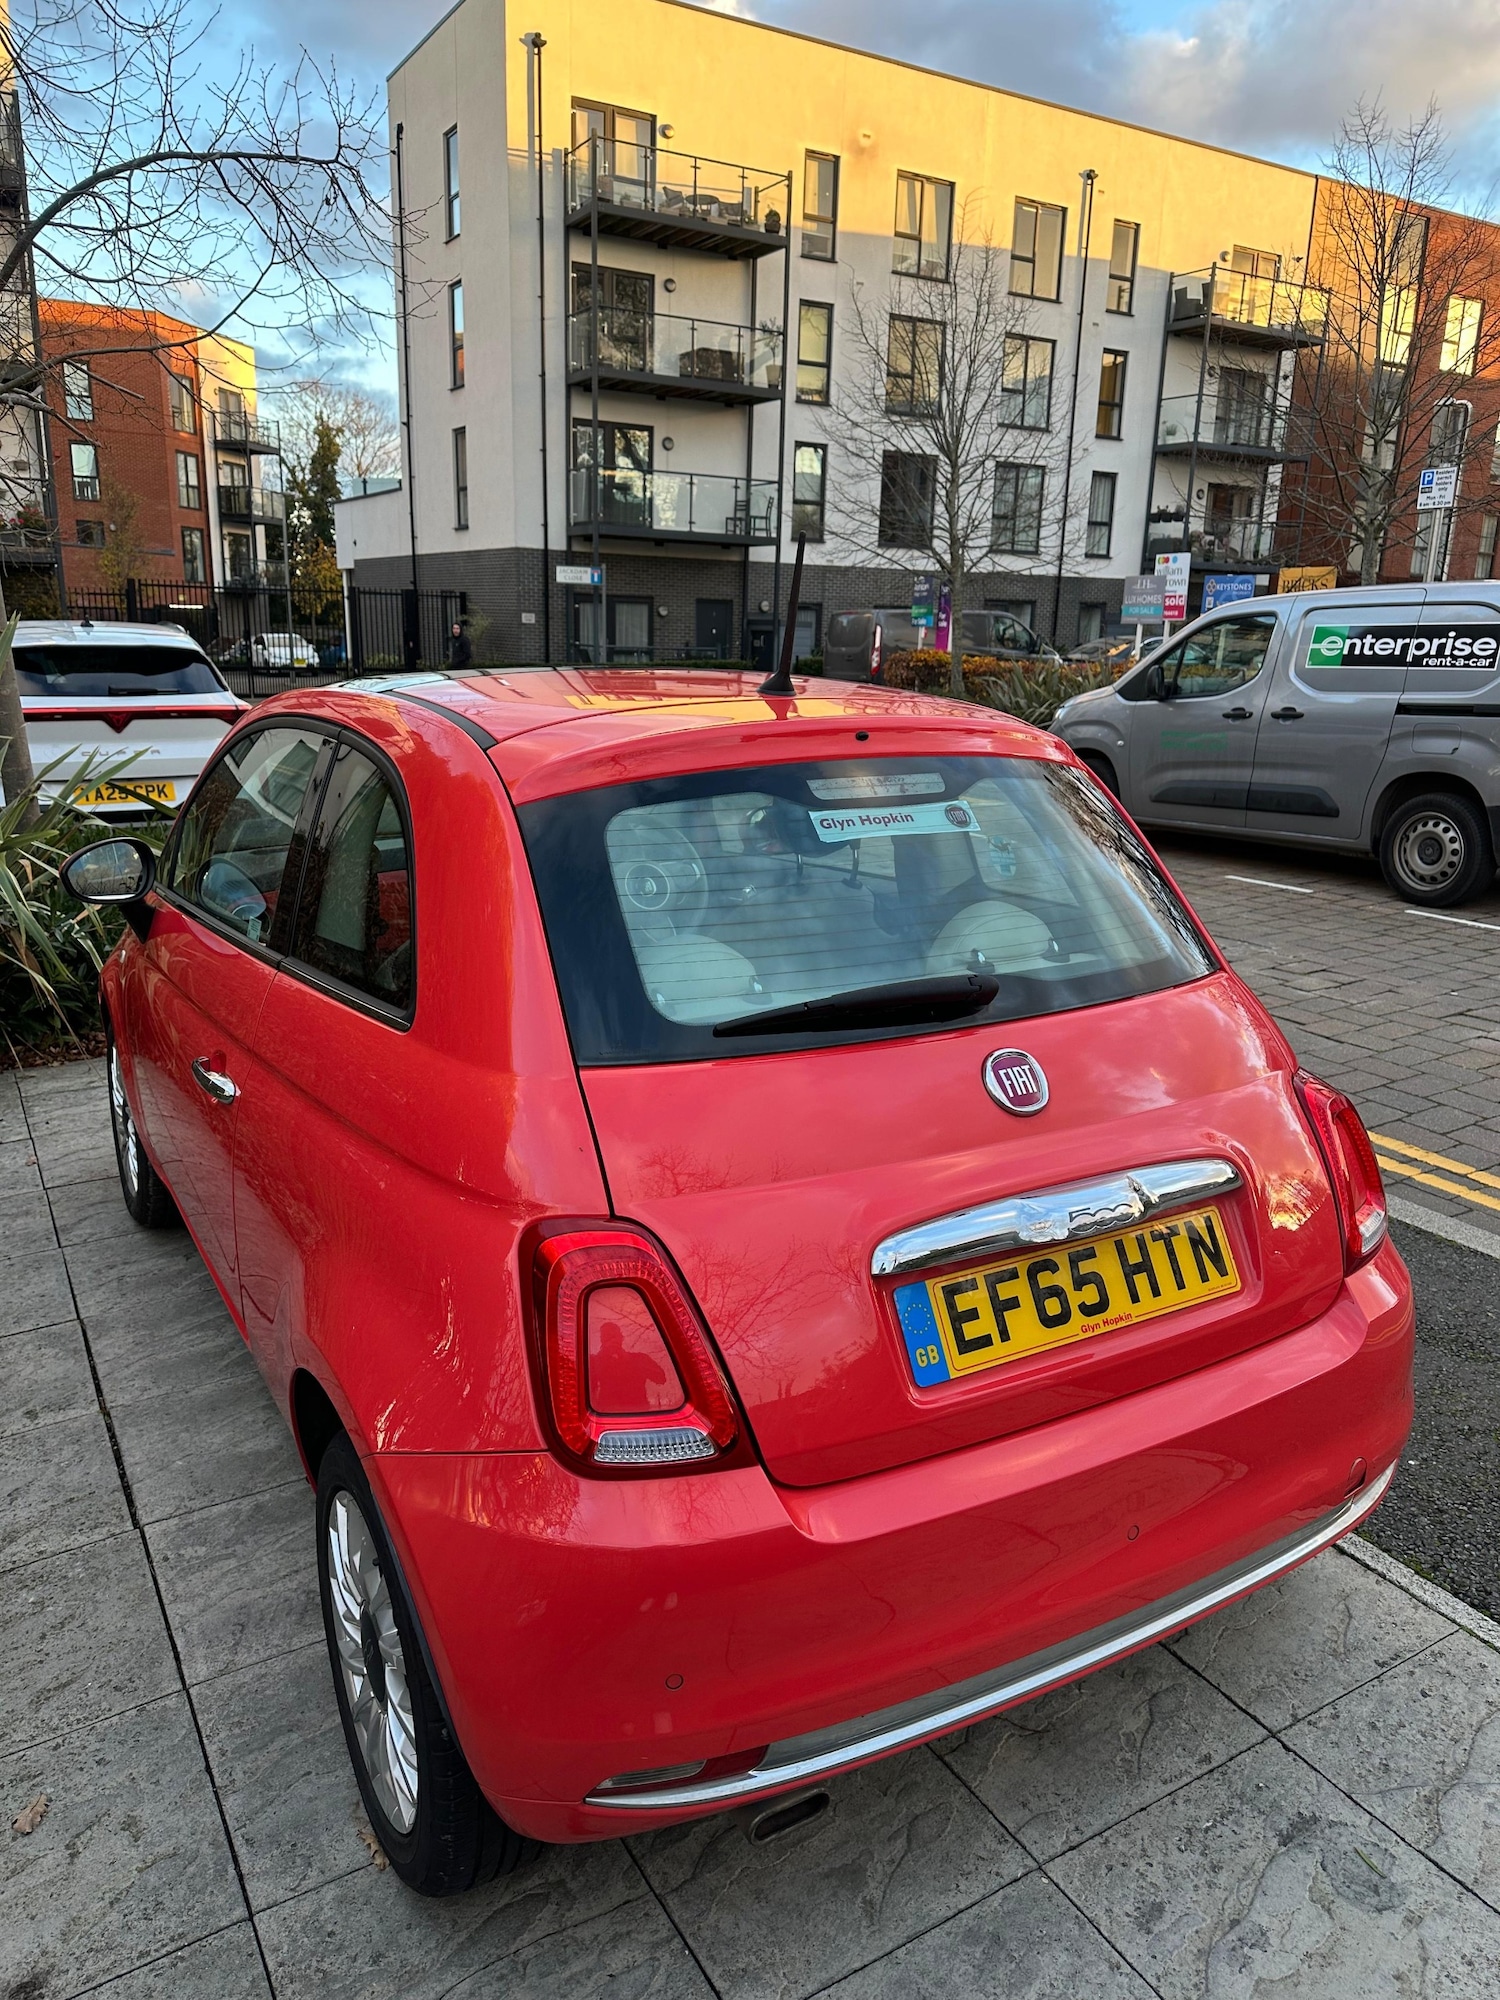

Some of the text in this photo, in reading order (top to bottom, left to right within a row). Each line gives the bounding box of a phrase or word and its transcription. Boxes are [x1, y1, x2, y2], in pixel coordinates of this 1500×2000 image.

[1424, 473, 1433, 485] P
[1165, 578, 1187, 588] rown
[1216, 582, 1252, 591] KEYSTONES
[1165, 594, 1185, 606] sold
[1140, 607, 1154, 615] SALE
[1320, 631, 1497, 662] enterprise
[1422, 657, 1493, 667] rent-a-car
[819, 812, 914, 831] Glyn Hopkin
[998, 1064, 1038, 1098] FIAT
[1067, 1203, 1135, 1234] 500
[940, 1215, 1230, 1357] EF65 HTN
[1080, 1311, 1134, 1335] Glyn Hopkin
[915, 1344, 940, 1369] GB
